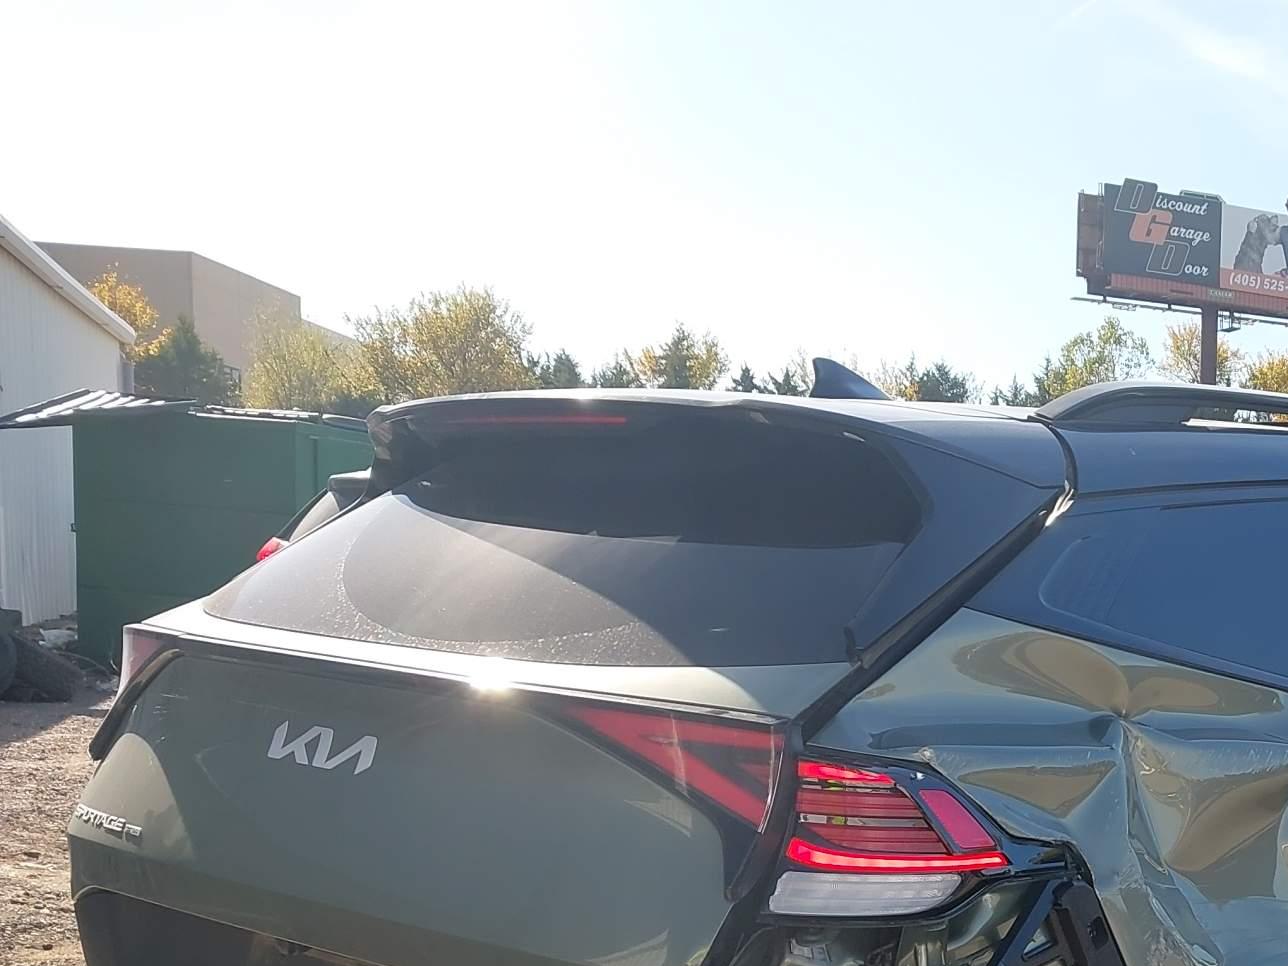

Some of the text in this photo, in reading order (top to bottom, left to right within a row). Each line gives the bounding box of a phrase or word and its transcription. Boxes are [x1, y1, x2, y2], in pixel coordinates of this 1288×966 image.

[1114, 178, 1208, 215] Discount
[1129, 209, 1211, 246] Garage
[1145, 240, 1209, 277] Door
[1229, 271, 1261, 290] (405)
[267, 720, 378, 775] KIA
